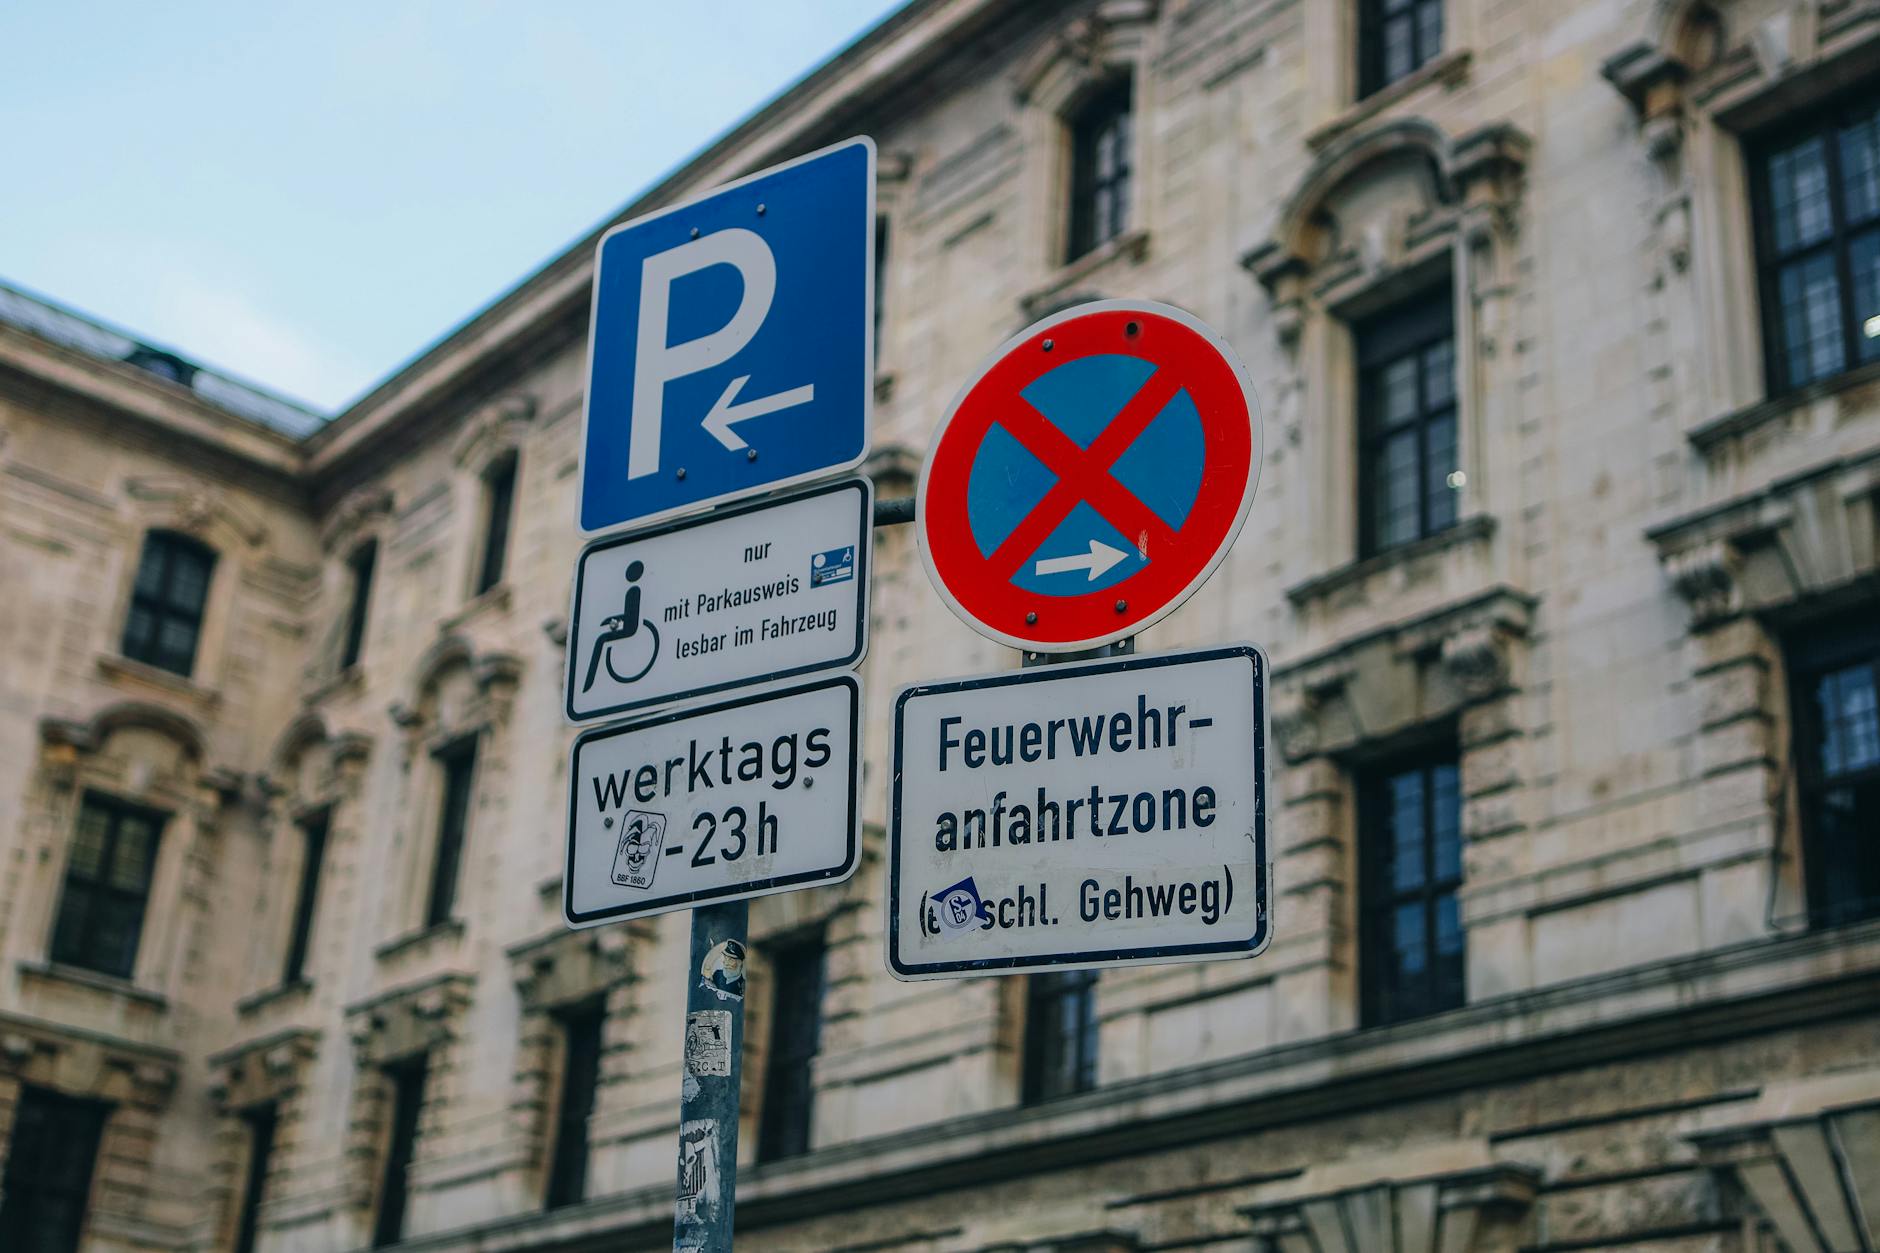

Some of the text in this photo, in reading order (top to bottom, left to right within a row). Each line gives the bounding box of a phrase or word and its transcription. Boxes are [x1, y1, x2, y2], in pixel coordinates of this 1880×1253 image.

[627, 228, 777, 481] P
[744, 542, 772, 563] nur
[664, 574, 800, 623] mit Parkausweis
[676, 608, 837, 660] lesbar im Fahrzeug
[939, 694, 1213, 772] Feuerwehr-
[592, 727, 832, 812] werktags
[935, 785, 1217, 853] anfahrtzone
[1079, 864, 1234, 926] Gehweg)
